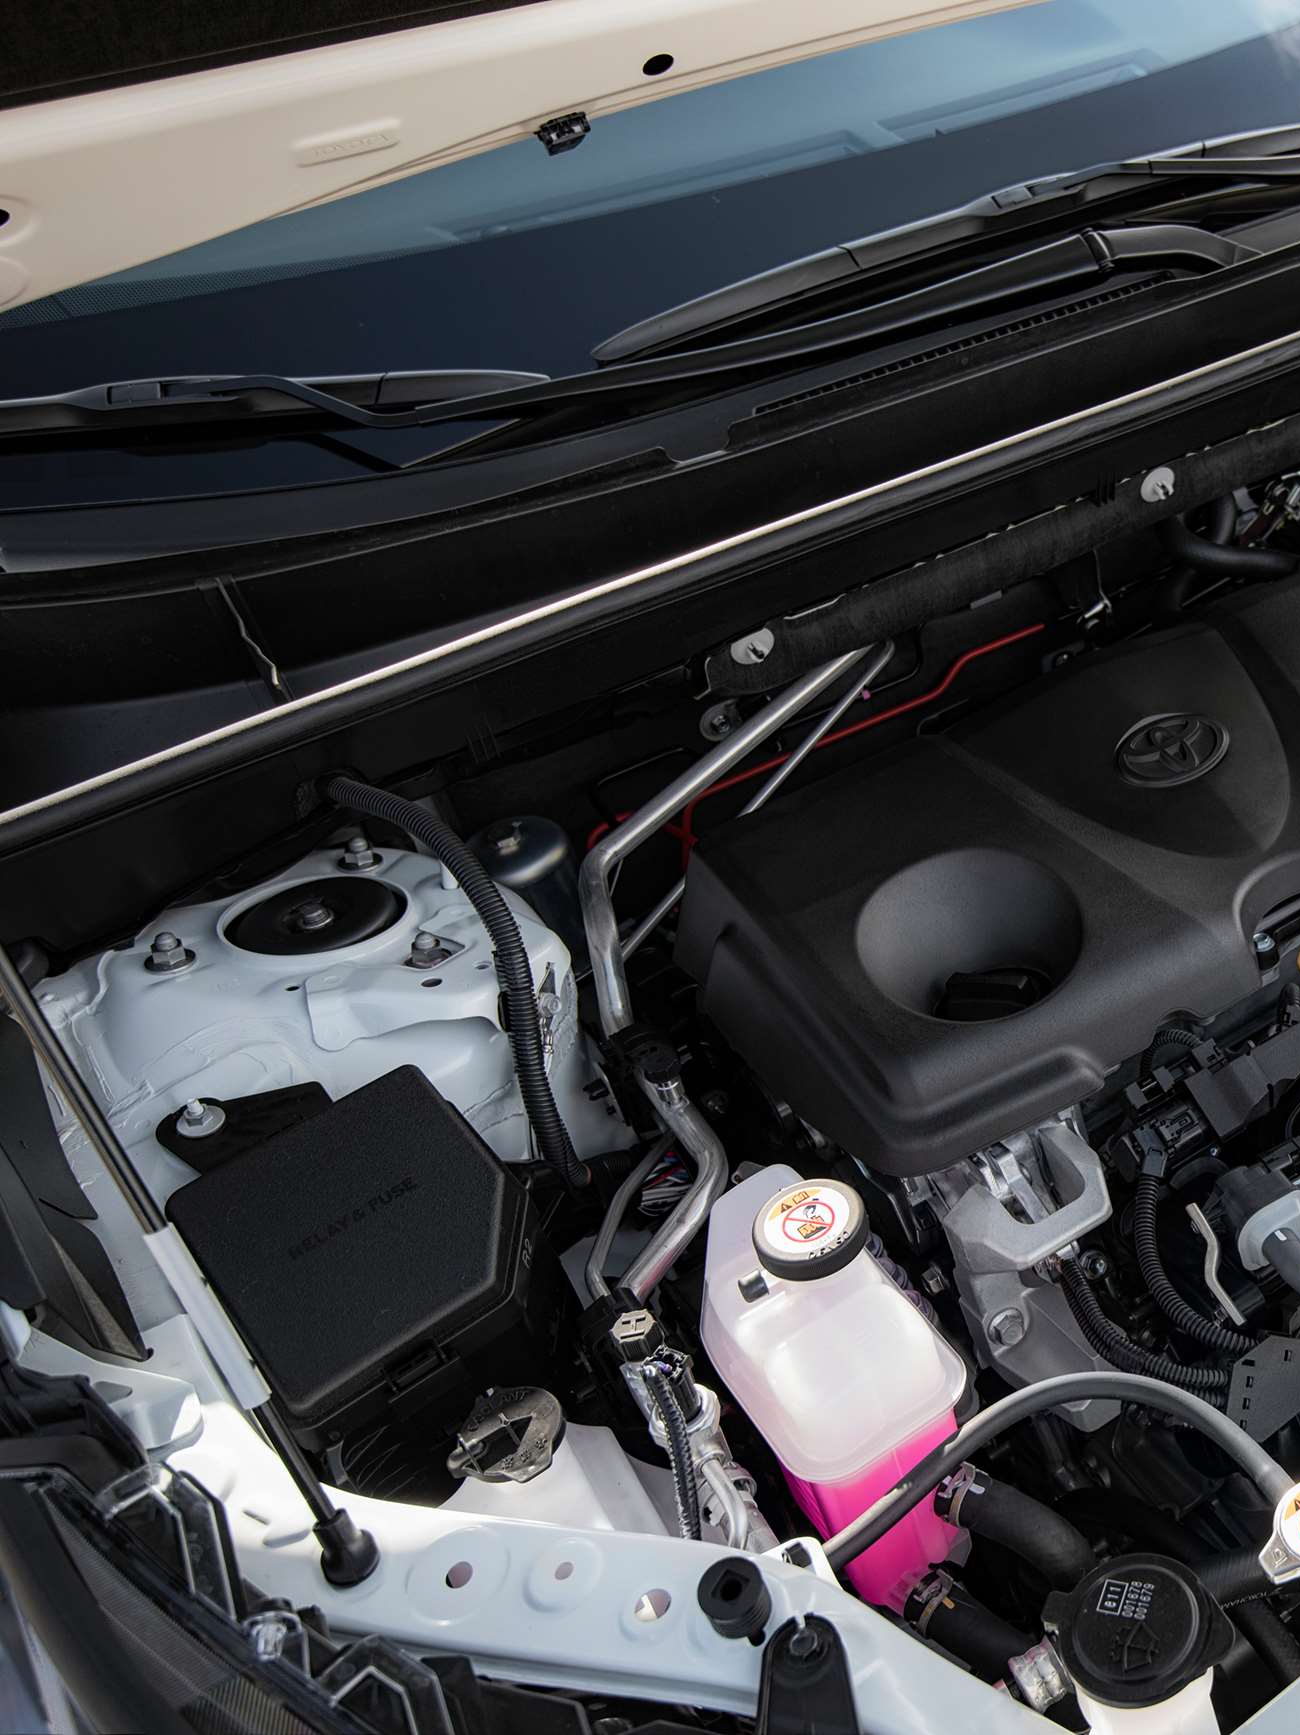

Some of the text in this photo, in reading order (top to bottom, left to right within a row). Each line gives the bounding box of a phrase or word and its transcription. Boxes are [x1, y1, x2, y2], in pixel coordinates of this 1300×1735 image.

[288, 1214, 352, 1260] RELAY
[368, 1176, 418, 1212] FUSE
[1104, 1586, 1122, 1608] e11
[1134, 1583, 1155, 1620] 001679
